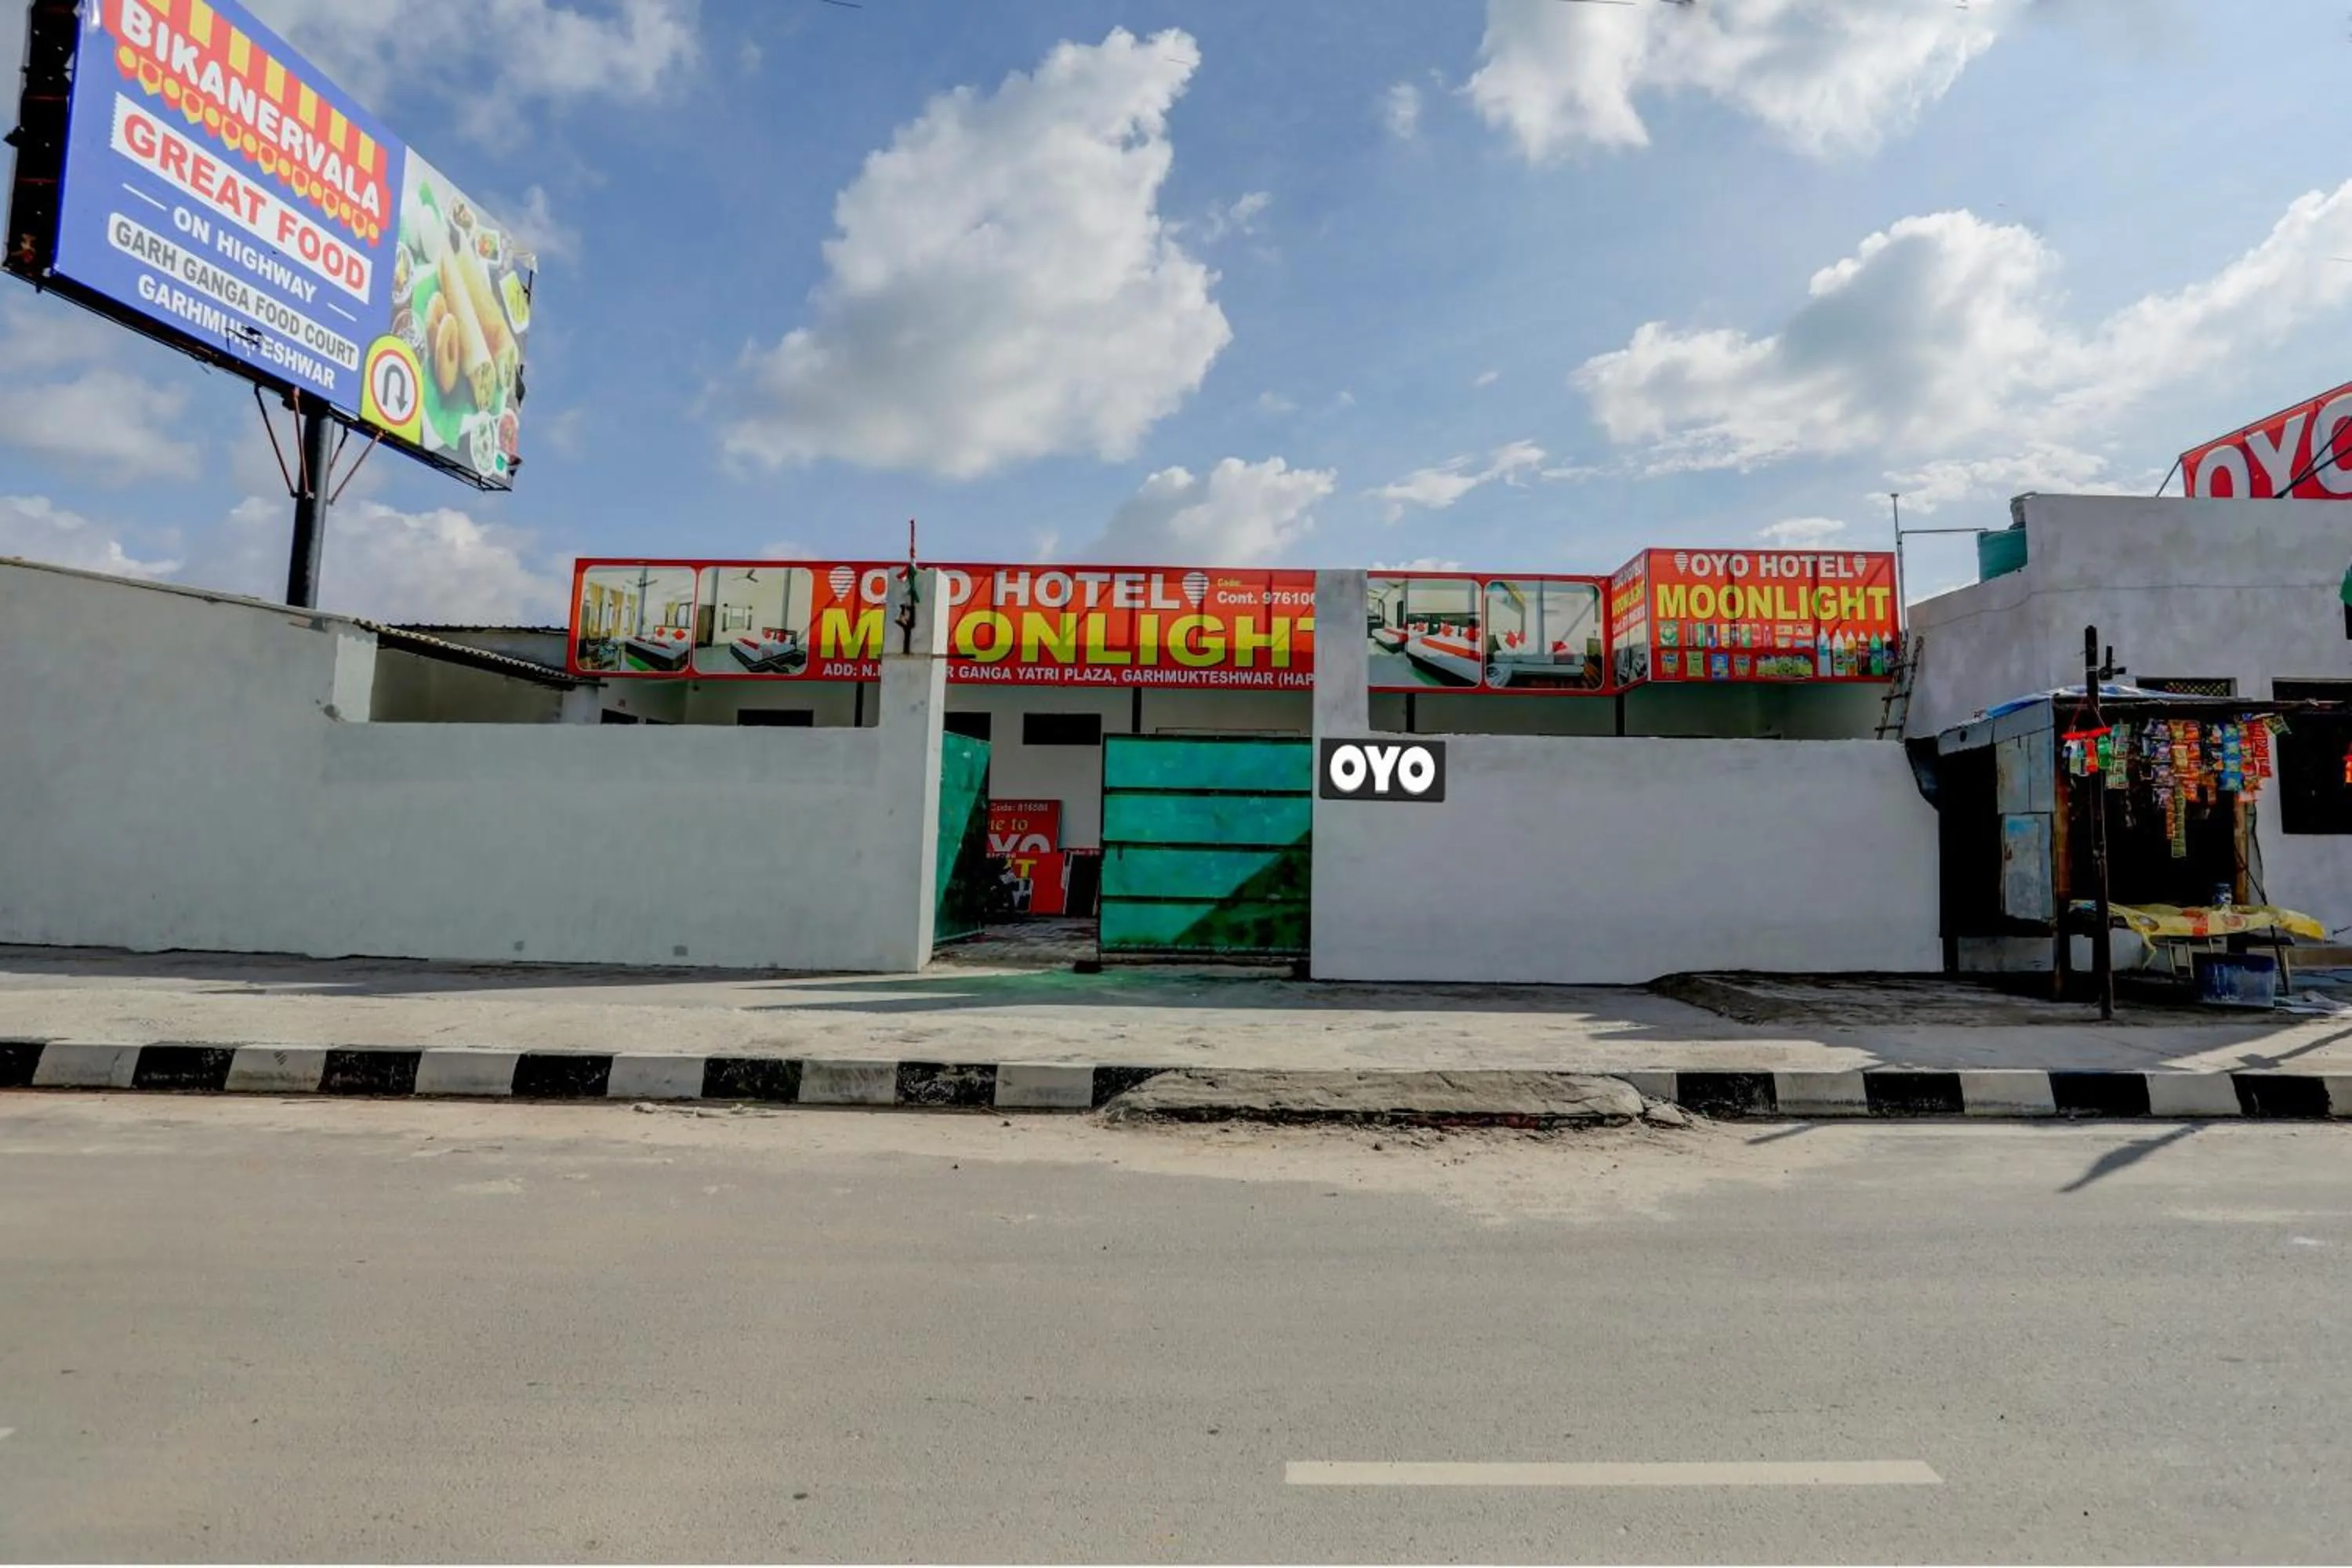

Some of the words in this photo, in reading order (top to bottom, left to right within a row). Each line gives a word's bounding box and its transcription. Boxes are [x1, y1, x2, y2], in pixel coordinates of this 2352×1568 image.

[121, 0, 379, 217] BIKANERVALA
[124, 114, 267, 226] GREAT
[277, 209, 365, 290] FOOD
[173, 207, 210, 245] ON
[217, 227, 317, 303] HIGHWAY
[116, 221, 177, 271] GARH
[183, 257, 250, 311] GANGA
[255, 295, 299, 336] FOOD
[304, 325, 355, 365] COURT
[860, 568, 973, 607] OO
[994, 570, 1181, 610] HOTEL
[1691, 554, 1749, 576] OYO
[1759, 554, 1853, 579] HOTEL
[1217, 590, 1258, 604] Cont.
[1656, 583, 1890, 622] MOONLIGHT
[820, 608, 1316, 667] MONLIGH
[823, 663, 857, 677] ADD:
[959, 666, 1011, 680] GANGA
[1017, 667, 1058, 681] YATRI
[1064, 669, 1116, 683] PLAZA,
[1122, 670, 1273, 685] GARHMUKTESHWAR
[1279, 672, 1316, 686] (HAP
[1330, 744, 1436, 796] OYO
[988, 833, 1051, 853] YO
